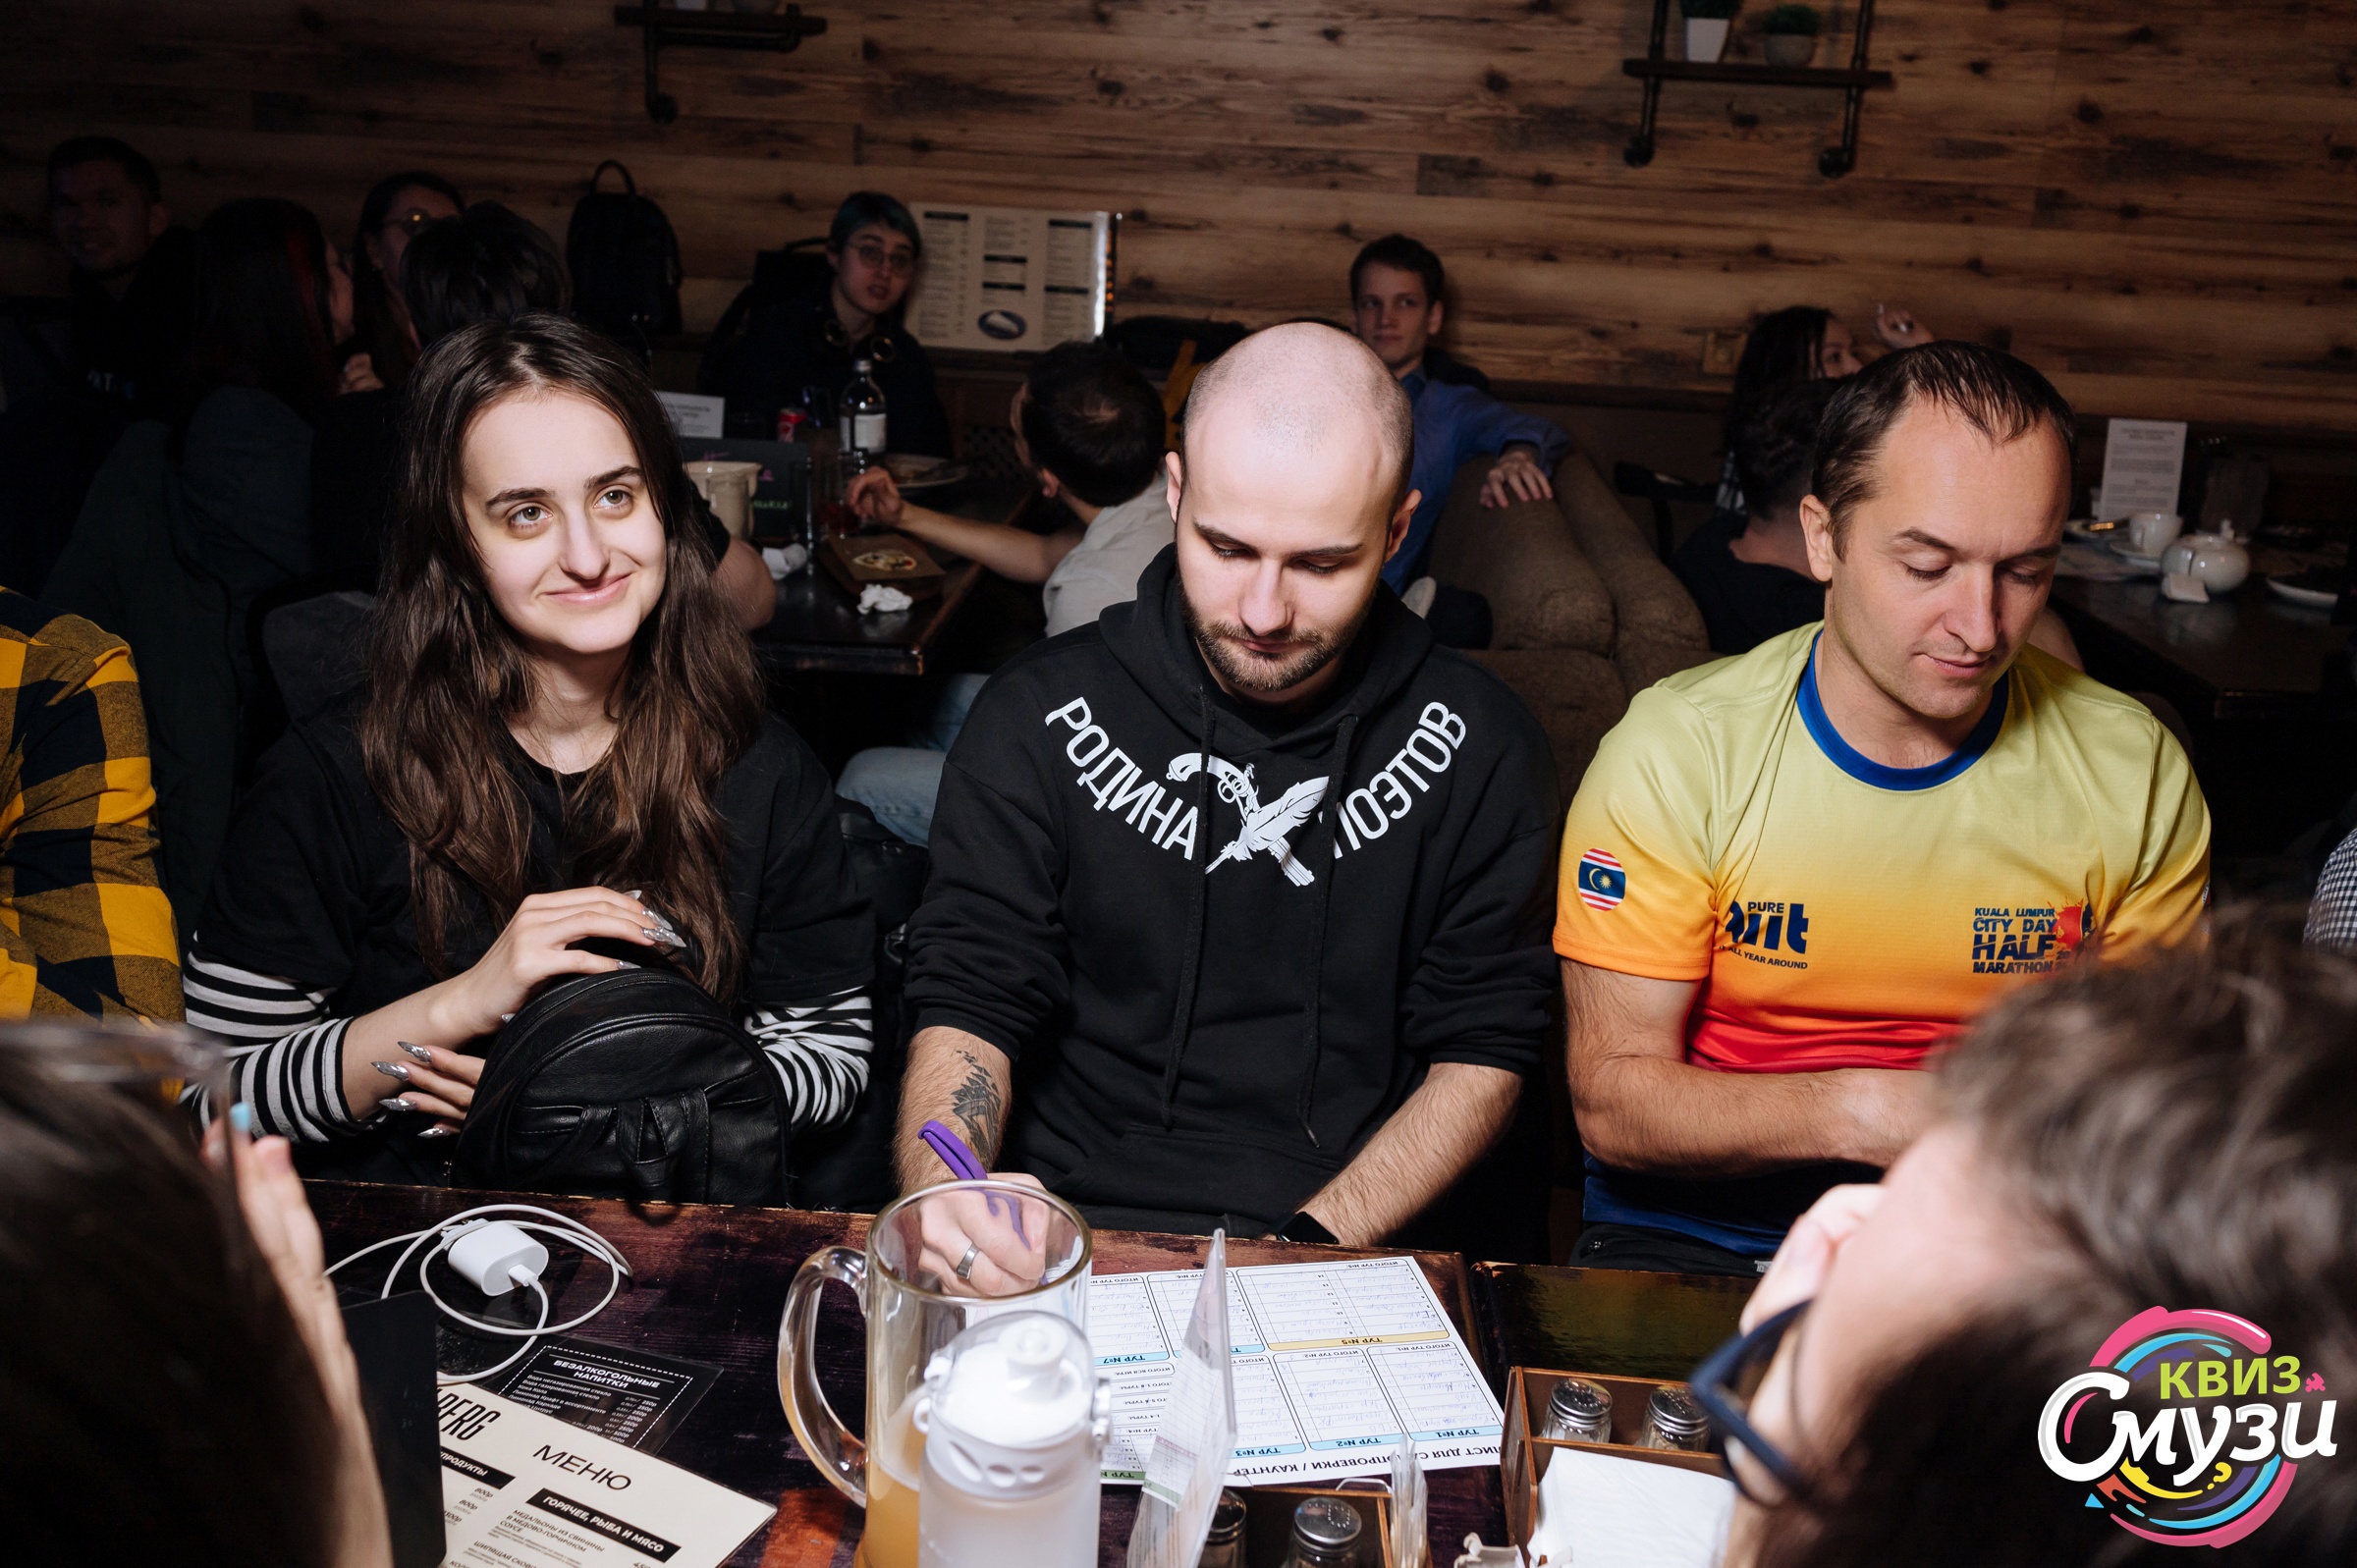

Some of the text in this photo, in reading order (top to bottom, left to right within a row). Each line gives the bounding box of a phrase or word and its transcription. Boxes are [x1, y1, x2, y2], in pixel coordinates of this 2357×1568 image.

[1045, 696, 1200, 861] РОДИНА
[1747, 901, 1784, 914] PURE
[1974, 907, 2056, 917] KUALA LUMPUR
[1973, 917, 2058, 933] CITY DAY
[1972, 934, 2057, 960] HALF
[1743, 950, 1767, 964] YEAR
[1767, 957, 1808, 969] AROUND
[1972, 961, 2053, 974] MARATHON
[553, 1359, 661, 1388] БЕЗАЛКОГОЛЬНЫЕ
[574, 1371, 630, 1389] НАПИТКИ
[537, 1382, 579, 1395] газированная
[542, 1378, 591, 1392] негазированная
[590, 1388, 612, 1397] стекло
[508, 1394, 536, 1405] Лимонад
[535, 1399, 562, 1410] Каркаде
[512, 1389, 540, 1400] Лимонад
[540, 1394, 560, 1405] Крафт
[564, 1401, 607, 1414] ассортименте
[437, 1387, 502, 1440] BERG
[613, 1430, 630, 1438] 500р
[1432, 1447, 1460, 1459] ДЛЯ
[440, 1451, 488, 1477] ПРОДУКТЫ
[531, 1444, 631, 1490] МЕНЮ
[1233, 1464, 1297, 1477] КАУНТЕР
[474, 1487, 494, 1498] 800р
[459, 1499, 478, 1510] 800р
[499, 1521, 524, 1534] СОУСЕ
[513, 1509, 558, 1532] МЕДАЛЬОНЫ
[568, 1531, 605, 1552] СВИНИНЫ
[542, 1495, 664, 1552] ГОРЯЧЕЕ, РЫБА И МЯСО
[513, 1518, 587, 1552] МЕДОВО-ГОРЧИЧНОМ
[473, 1541, 513, 1560] ШИПЯЩАЯ
